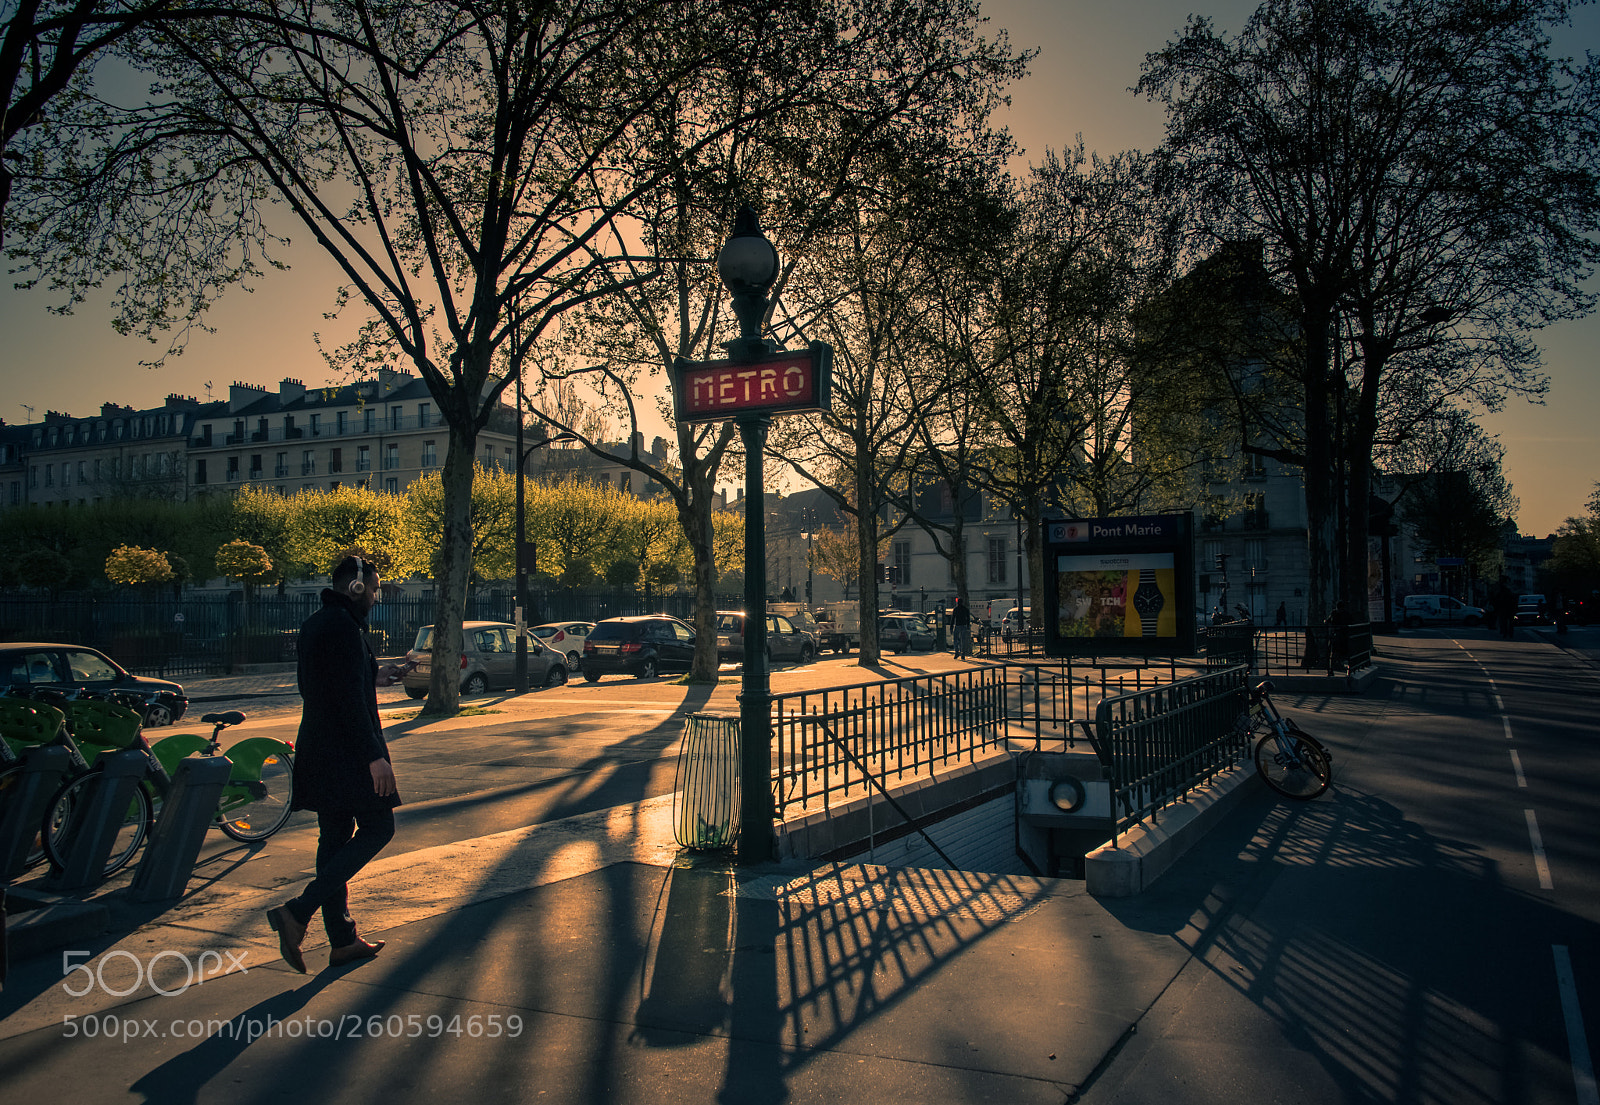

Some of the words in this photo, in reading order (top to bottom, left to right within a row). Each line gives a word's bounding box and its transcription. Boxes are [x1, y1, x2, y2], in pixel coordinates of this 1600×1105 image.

[693, 366, 805, 407] METRO
[1093, 525, 1121, 538] Pont
[1125, 523, 1162, 536] Marie
